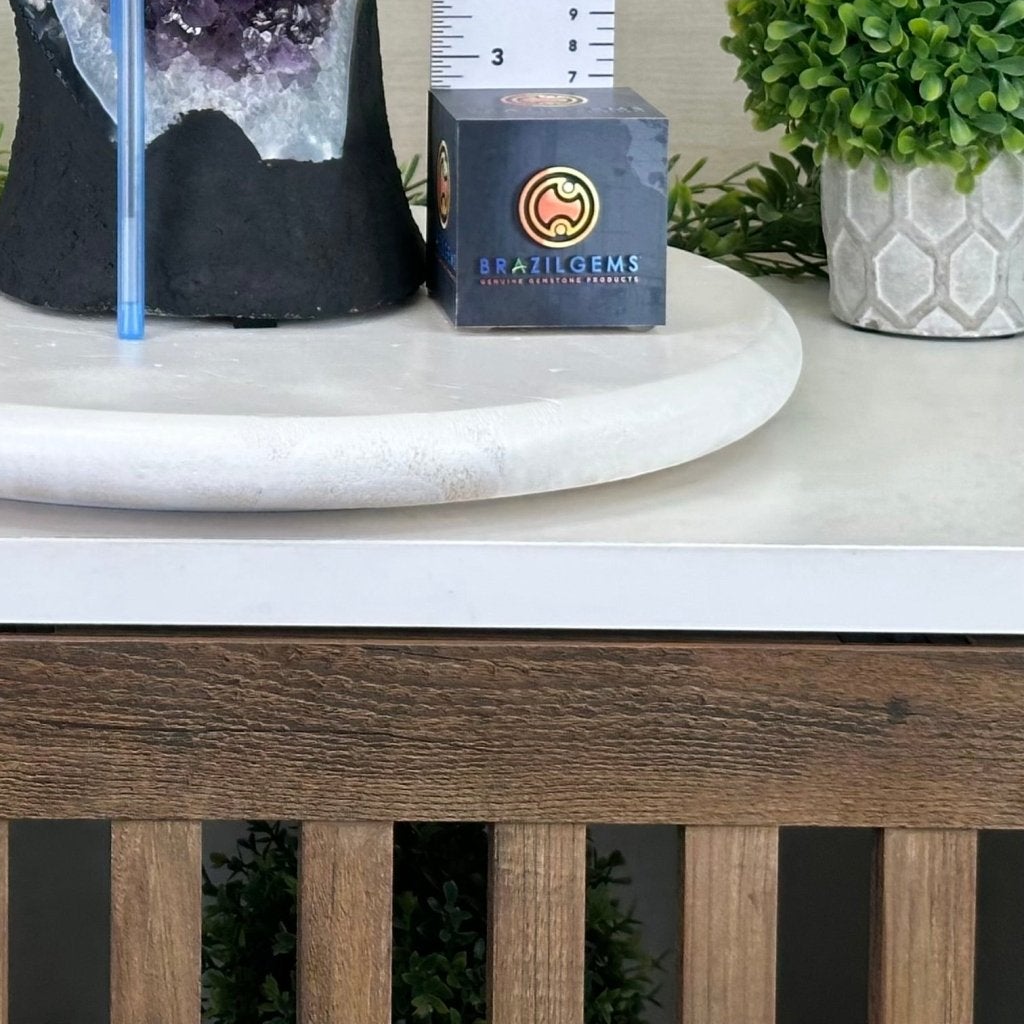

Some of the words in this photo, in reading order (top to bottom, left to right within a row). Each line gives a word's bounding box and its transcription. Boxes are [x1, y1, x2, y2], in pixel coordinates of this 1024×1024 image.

[569, 8, 578, 20] 9
[569, 40, 577, 52] 8
[492, 48, 503, 66] 3
[568, 71, 577, 82] 7
[479, 255, 639, 274] BRAZILGEMS
